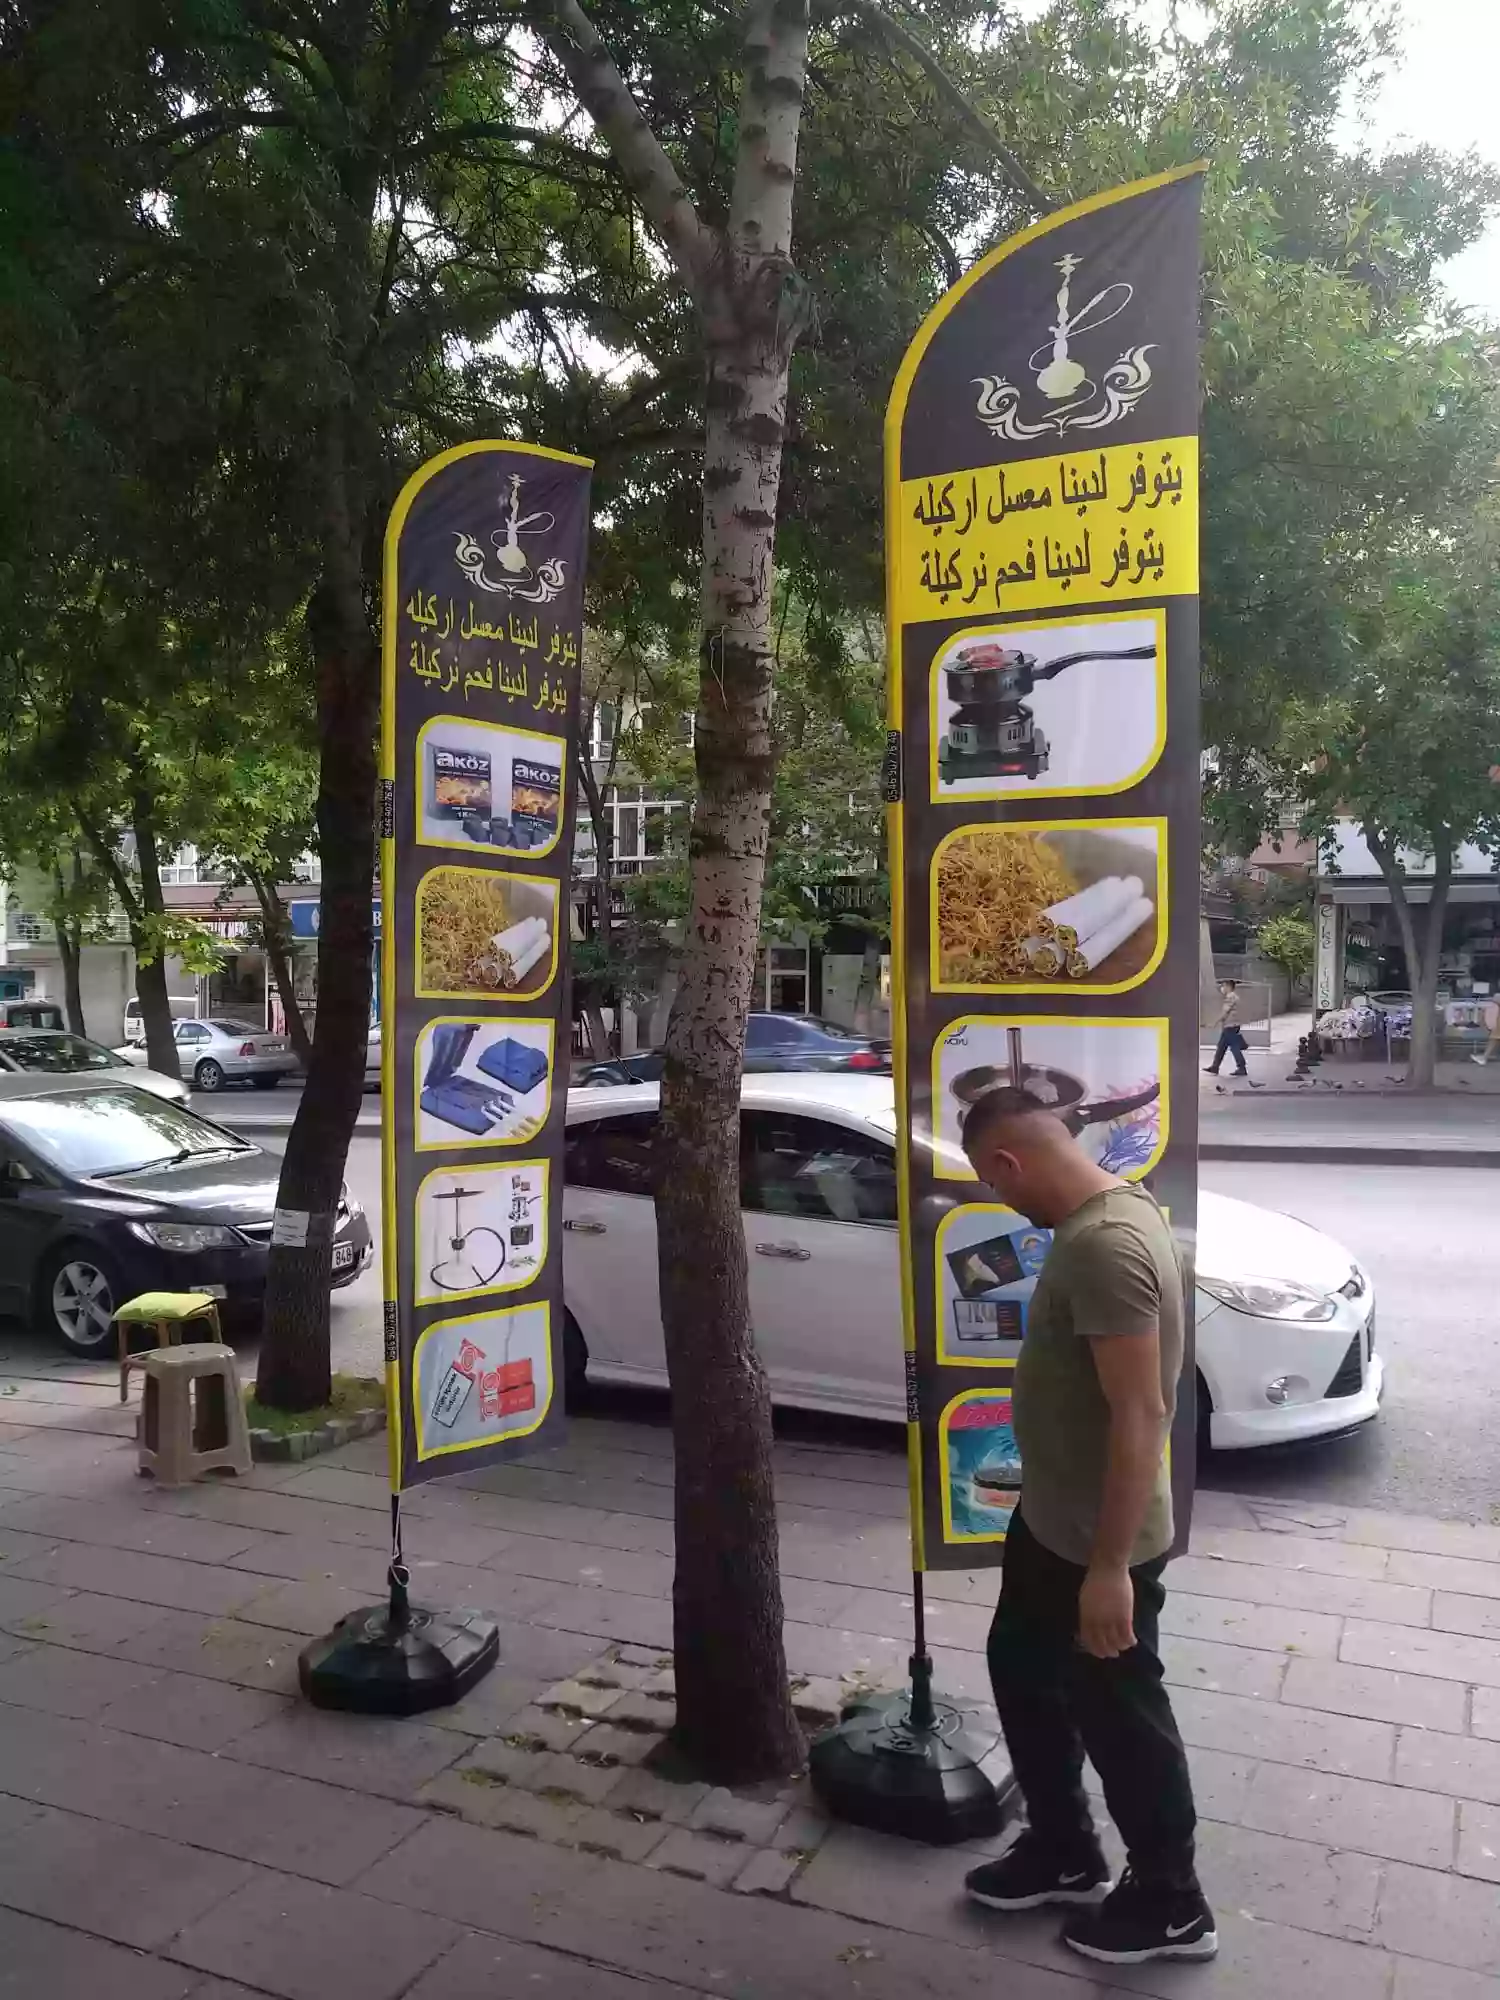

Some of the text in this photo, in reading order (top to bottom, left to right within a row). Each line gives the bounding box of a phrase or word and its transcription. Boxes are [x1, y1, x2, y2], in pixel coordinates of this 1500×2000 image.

[987, 469, 1052, 525] معسل
[1060, 454, 1107, 518] لدينا
[1117, 452, 1183, 514] يتوفر
[995, 538, 1036, 608] فحم
[1043, 528, 1091, 591] لدينا
[1100, 526, 1164, 588] يتوفر
[460, 600, 504, 641] معسل
[508, 612, 538, 656] لدينا
[544, 624, 577, 669] يتوفر
[464, 657, 493, 704] فحم
[498, 660, 528, 703] لدينا
[532, 671, 567, 714] يتوفر
